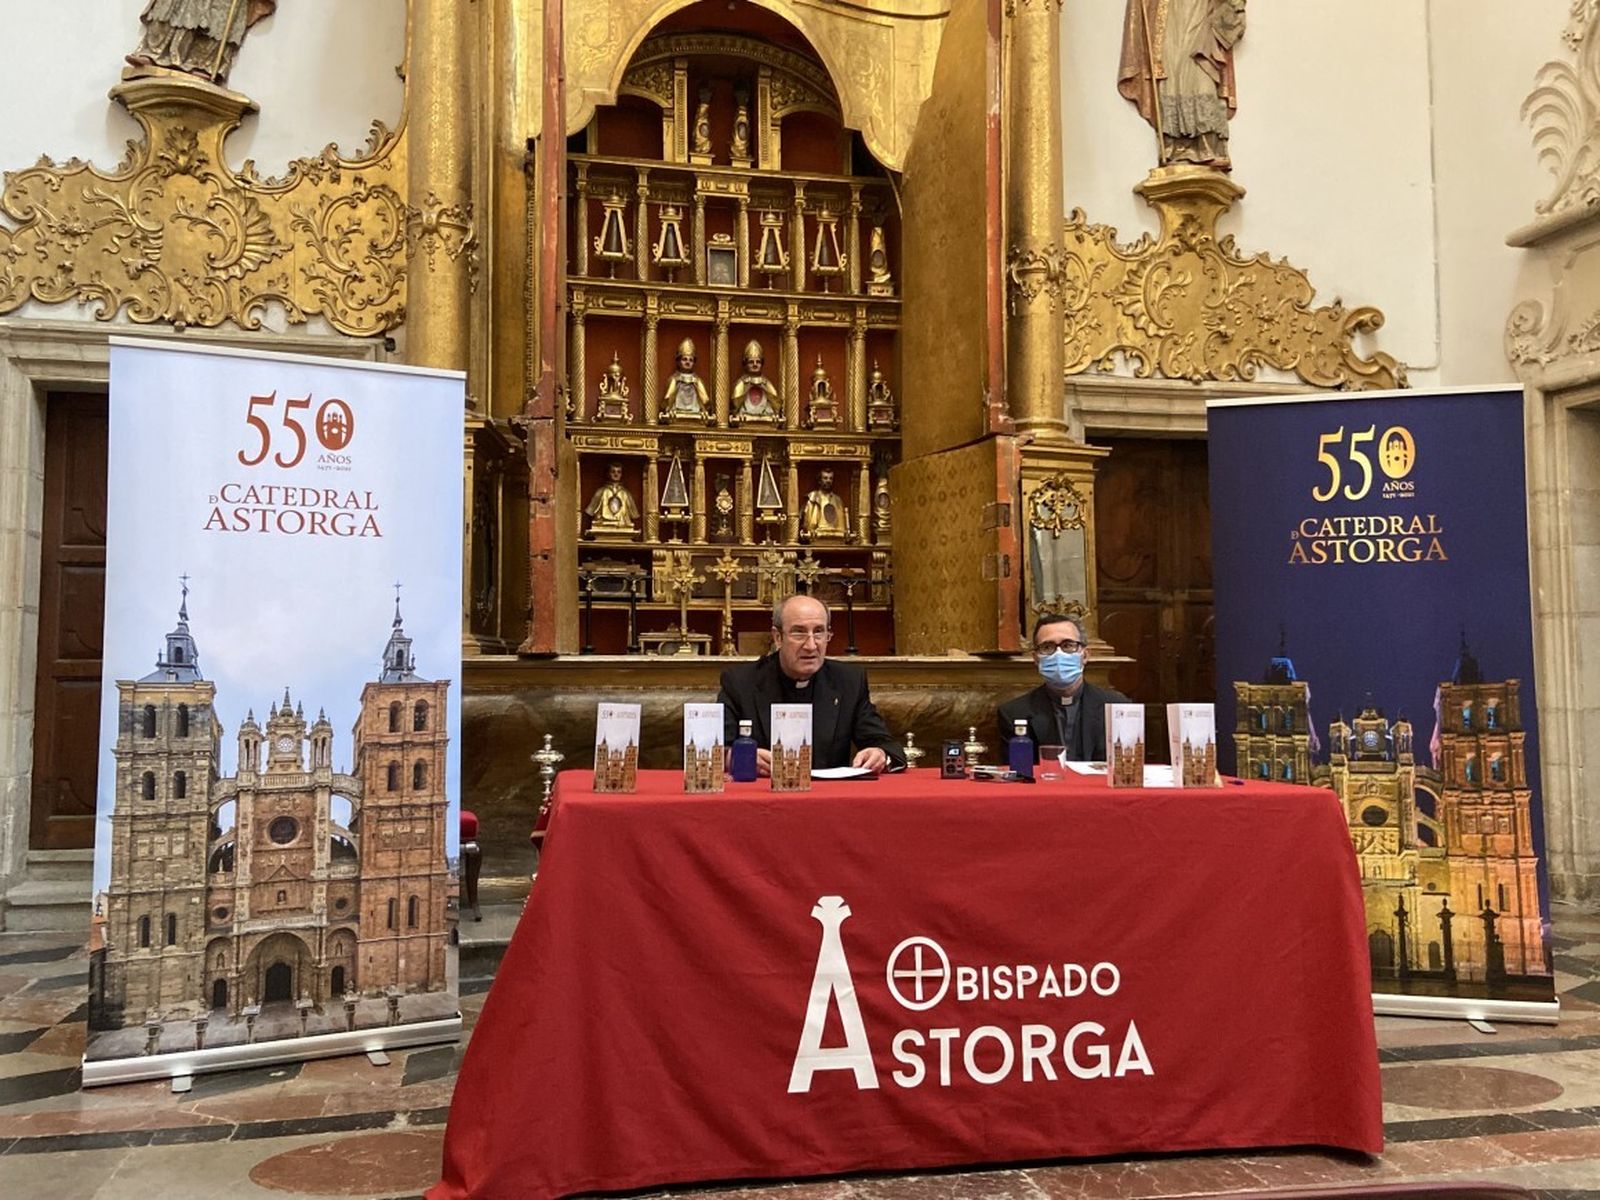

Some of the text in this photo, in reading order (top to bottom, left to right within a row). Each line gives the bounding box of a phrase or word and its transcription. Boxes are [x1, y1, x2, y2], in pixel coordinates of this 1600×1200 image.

[238, 390, 354, 468] 550
[317, 453, 352, 465] AÑOS
[1312, 424, 1417, 502] 550
[220, 484, 379, 511] CATEDRAL
[1382, 480, 1415, 492] AÑOS
[204, 507, 383, 537] ASTORGA
[1300, 514, 1443, 538] CATEDRAL
[1288, 537, 1449, 564] ASTORGA
[887, 937, 1120, 1010] OBISPADO
[788, 896, 1154, 1094] ASTORGA
